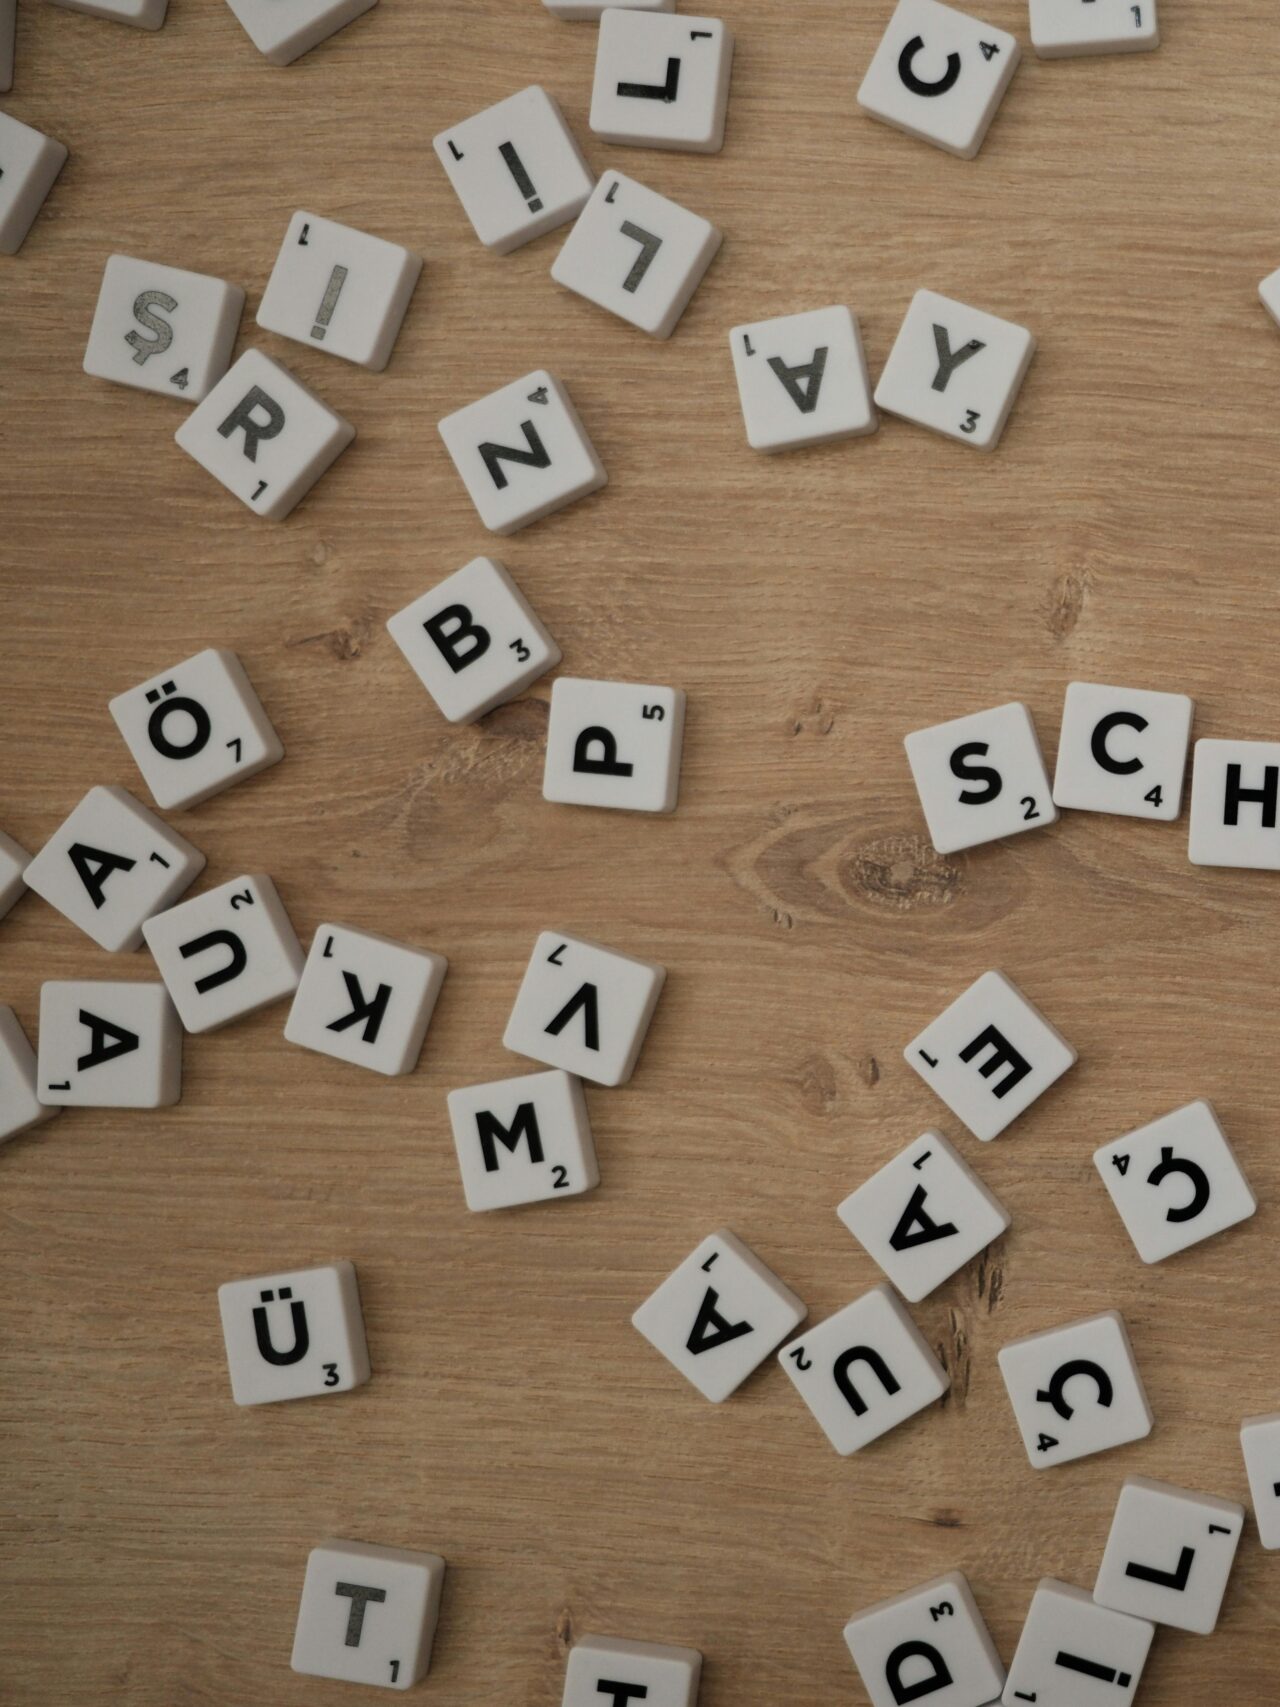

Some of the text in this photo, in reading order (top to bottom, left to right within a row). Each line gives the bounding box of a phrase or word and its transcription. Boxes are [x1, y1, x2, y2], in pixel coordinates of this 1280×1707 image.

[1130, 4, 1142, 28] 1
[616, 30, 713, 104] L 1
[897, 34, 1001, 98] C 4
[446, 139, 465, 162] 1
[297, 223, 310, 247] 1
[604, 181, 663, 294] L 1
[123, 290, 190, 391] Ş 4
[742, 333, 829, 415] A 1
[930, 323, 987, 434] Y 3
[526, 386, 549, 406] 4
[216, 384, 286, 502] R 1
[421, 603, 531, 675] B 3
[144, 679, 242, 764] Ö 7
[572, 704, 666, 778] P 5
[1019, 795, 1041, 821] 2
[1143, 784, 1164, 808] 4
[66, 841, 171, 911] A 1
[178, 888, 255, 996] U 2
[322, 935, 393, 1045] K 1
[543, 943, 600, 1053] V 7
[47, 1008, 140, 1091] A 1
[917, 1023, 1034, 1100] E 1
[474, 1101, 571, 1190] M 2
[1111, 1145, 1211, 1224] Ç 4
[888, 1150, 960, 1253] A 1
[251, 1286, 341, 1388] Ü 3
[685, 1251, 755, 1356] A 1
[788, 1344, 902, 1418] U 2
[1035, 1358, 1114, 1453] Ç 4
[1124, 1523, 1232, 1593] L 1
[334, 1581, 401, 1684] T 1
[885, 1600, 955, 1706] D 3
[1013, 1690, 1038, 1704] 1
